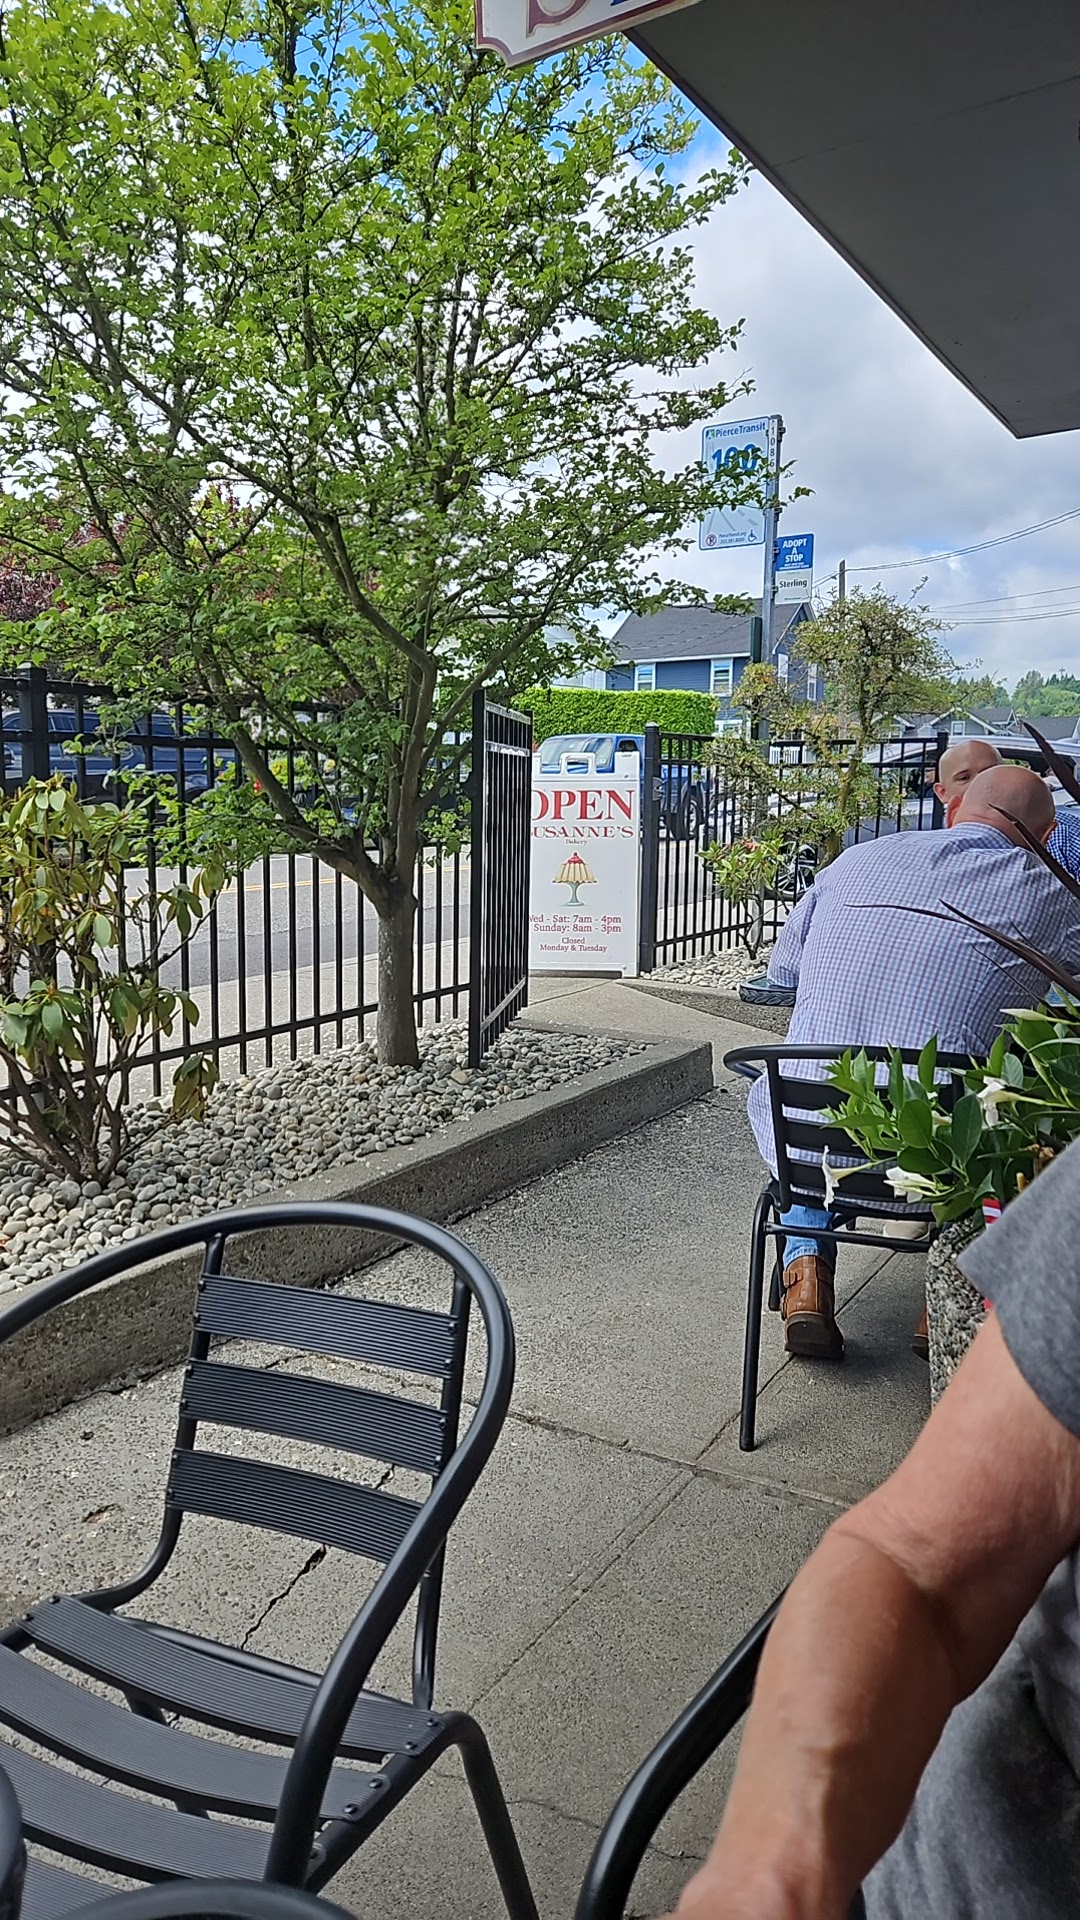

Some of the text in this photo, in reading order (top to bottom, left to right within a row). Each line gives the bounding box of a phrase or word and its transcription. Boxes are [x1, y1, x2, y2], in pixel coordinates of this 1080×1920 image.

[715, 422, 766, 438] PierceTransit
[782, 538, 808, 549] ADOPT
[791, 547, 798, 555] A
[785, 554, 804, 563] STOP
[779, 579, 808, 589] Sterling
[531, 826, 634, 839] USANNE'S
[552, 914, 570, 923] Sat:
[572, 914, 593, 923] 7am
[600, 915, 622, 925] 4pm
[533, 923, 570, 934] Sunday:
[572, 924, 593, 932] 8am
[600, 924, 622, 934] 3pm
[539, 944, 569, 952] Monday
[579, 944, 608, 952] Tuesday
